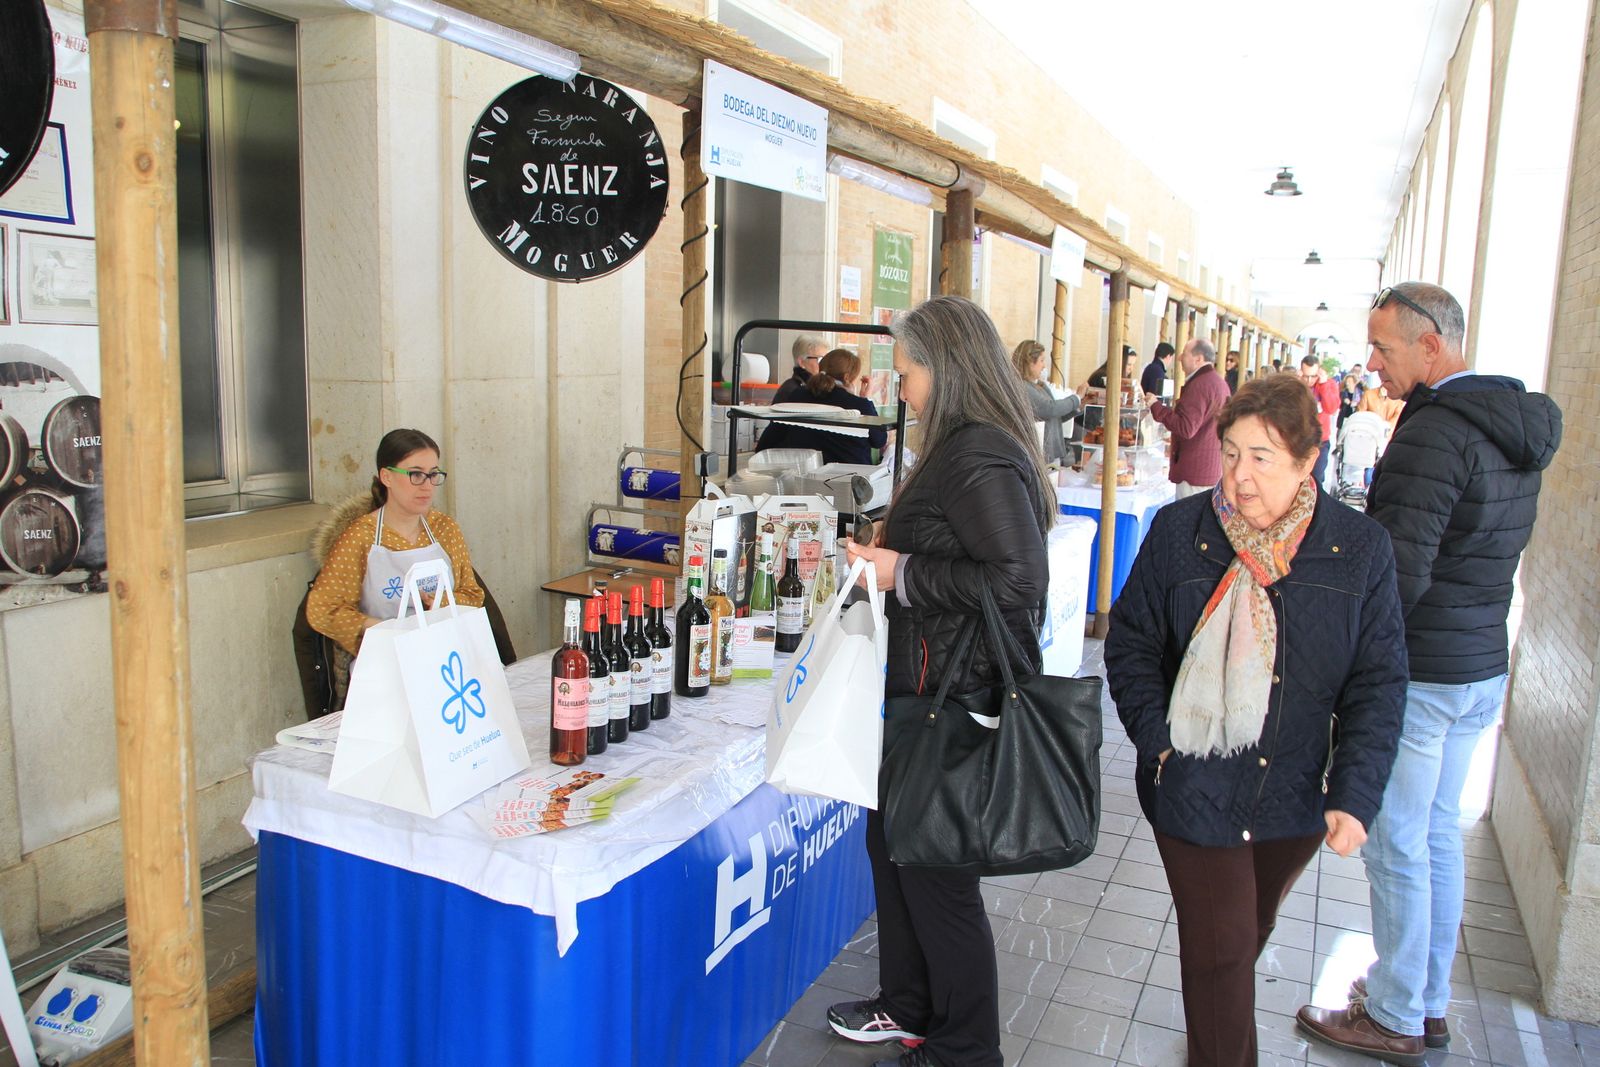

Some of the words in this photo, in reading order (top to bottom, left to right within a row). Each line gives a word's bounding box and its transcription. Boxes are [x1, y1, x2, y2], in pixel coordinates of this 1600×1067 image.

[562, 75, 667, 191] NARANJA
[723, 93, 756, 119] BODEGA
[756, 105, 770, 124] DEL
[771, 111, 796, 134] DIEZMO
[796, 122, 817, 141] NUEVO
[469, 105, 510, 192] VINO
[526, 128, 607, 148] Formula
[559, 148, 578, 162] de
[764, 132, 783, 147] MOGUER
[521, 162, 619, 196] SAENZ
[496, 219, 640, 273] MOGUER
[73, 435, 101, 448] SAENZ
[24, 529, 52, 540] SAENZ
[480, 729, 501, 745] Huelva
[768, 796, 843, 858] DIPUTA
[772, 851, 798, 900] DE
[803, 802, 860, 874] HUELVA
